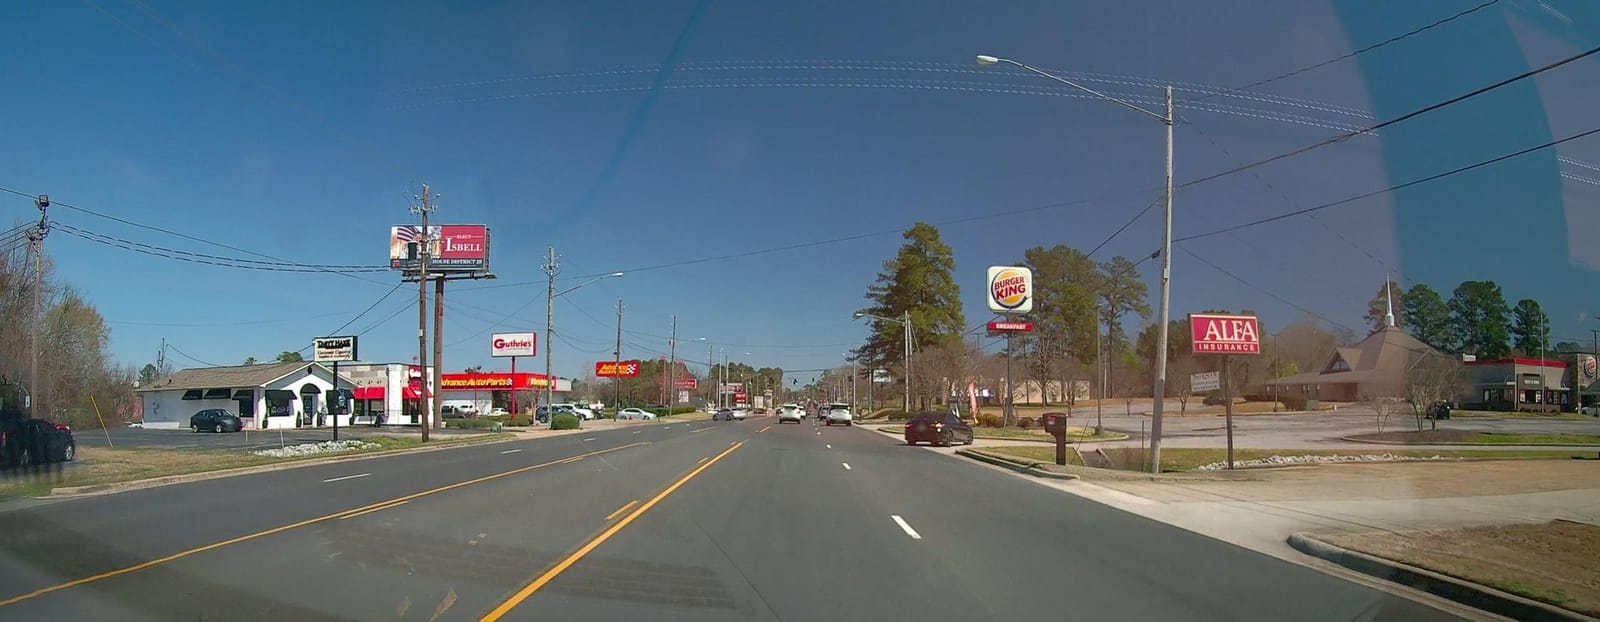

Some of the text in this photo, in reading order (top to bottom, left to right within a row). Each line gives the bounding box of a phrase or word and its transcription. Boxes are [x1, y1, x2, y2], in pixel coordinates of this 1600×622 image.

[445, 237, 482, 252] ISBELL
[994, 276, 1025, 291] BURGER
[996, 284, 1026, 300] KING
[1203, 320, 1257, 342] ALFA
[493, 338, 532, 349] Guthrie's
[1199, 343, 1255, 351] INSURANCE
[466, 378, 486, 387] Auto
[486, 378, 506, 386] Parts
